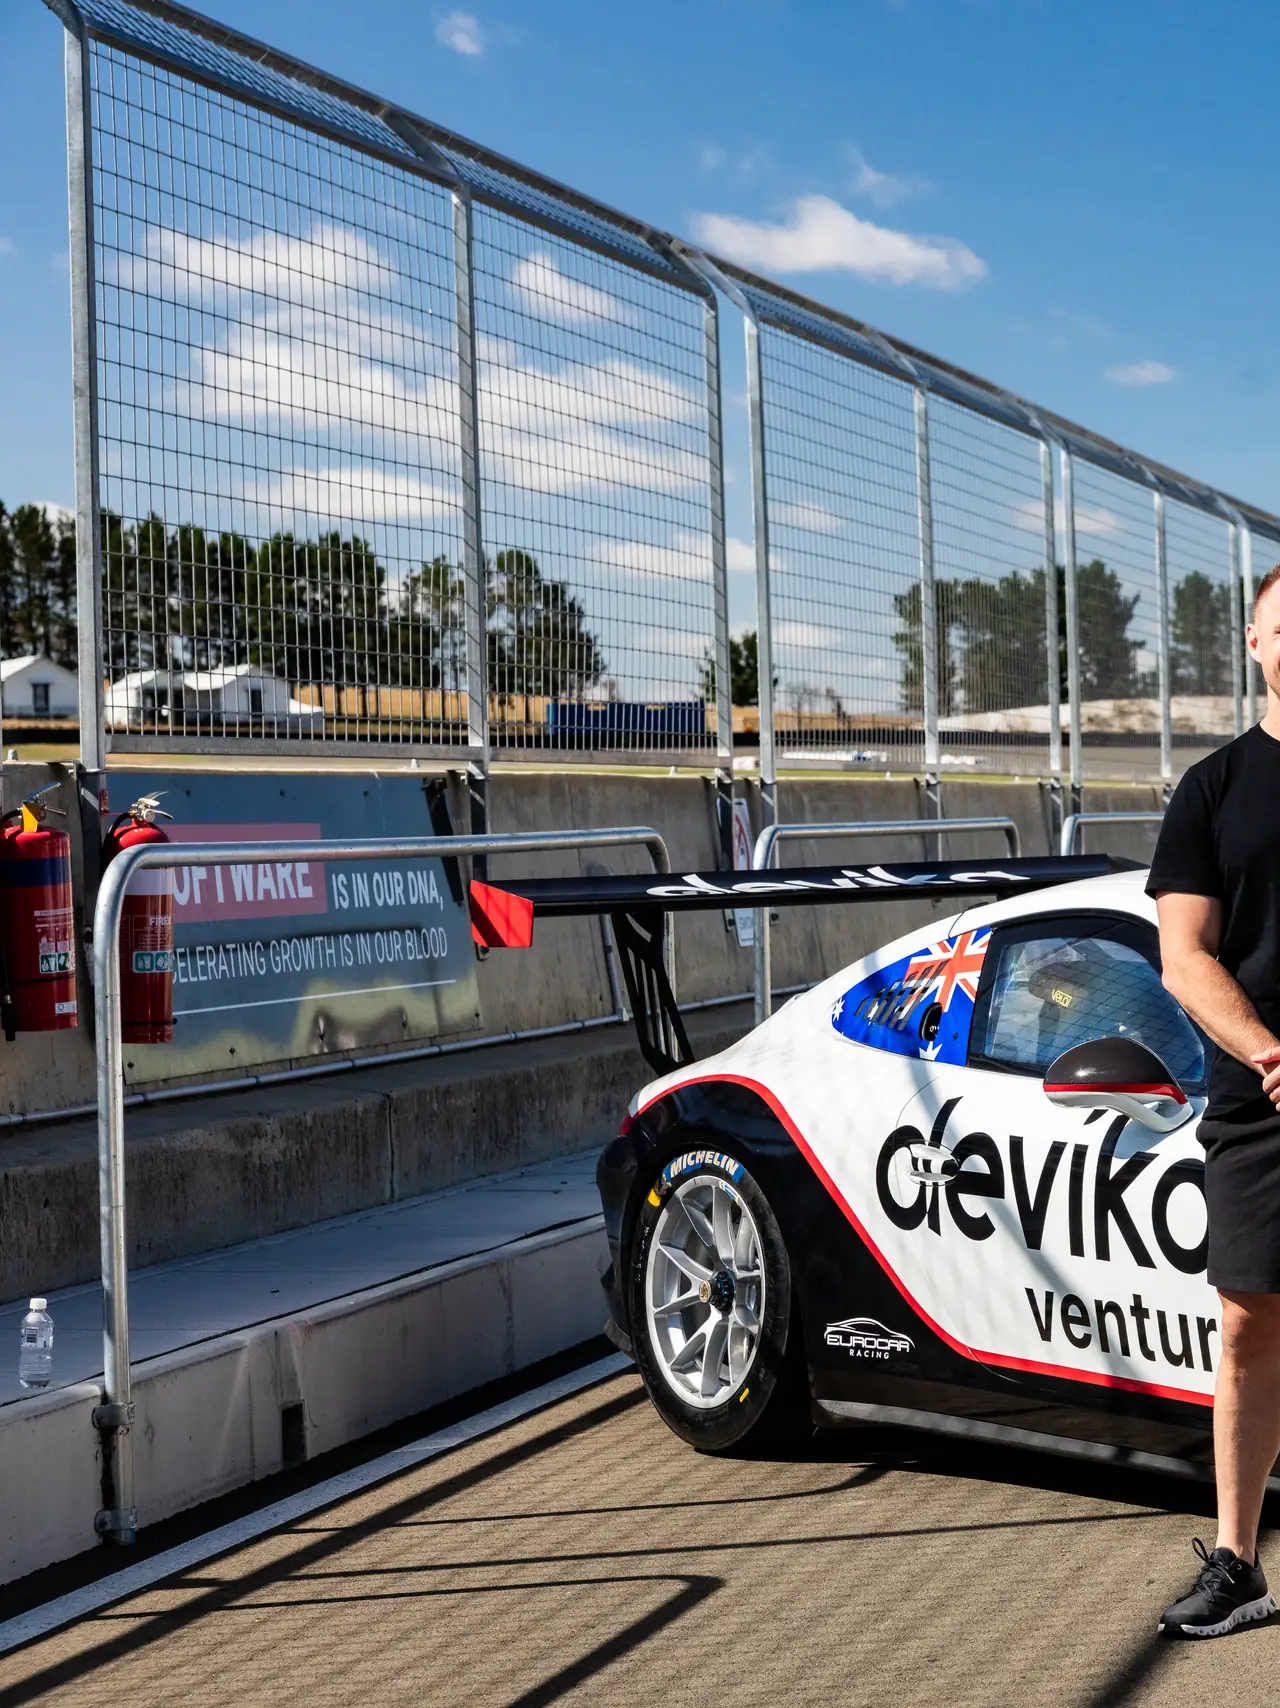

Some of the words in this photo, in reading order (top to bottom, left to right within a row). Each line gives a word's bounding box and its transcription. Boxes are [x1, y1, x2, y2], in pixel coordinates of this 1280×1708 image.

[173, 862, 313, 906] OFTWARE
[332, 873, 349, 909] IS
[352, 872, 370, 908] IN
[373, 871, 406, 907] OUR
[407, 870, 444, 911] DNA,
[646, 866, 1031, 896] devika
[270, 935, 337, 974] GROWTH
[340, 934, 354, 967] IS
[356, 933, 372, 965] IN
[374, 931, 404, 964] OUR
[405, 927, 447, 961] BLOOD
[670, 1151, 739, 1178] MICHELIN
[826, 1334, 910, 1353] EUROCAR
[1025, 1287, 1218, 1373] ventur
[849, 1349, 890, 1360] RACING
